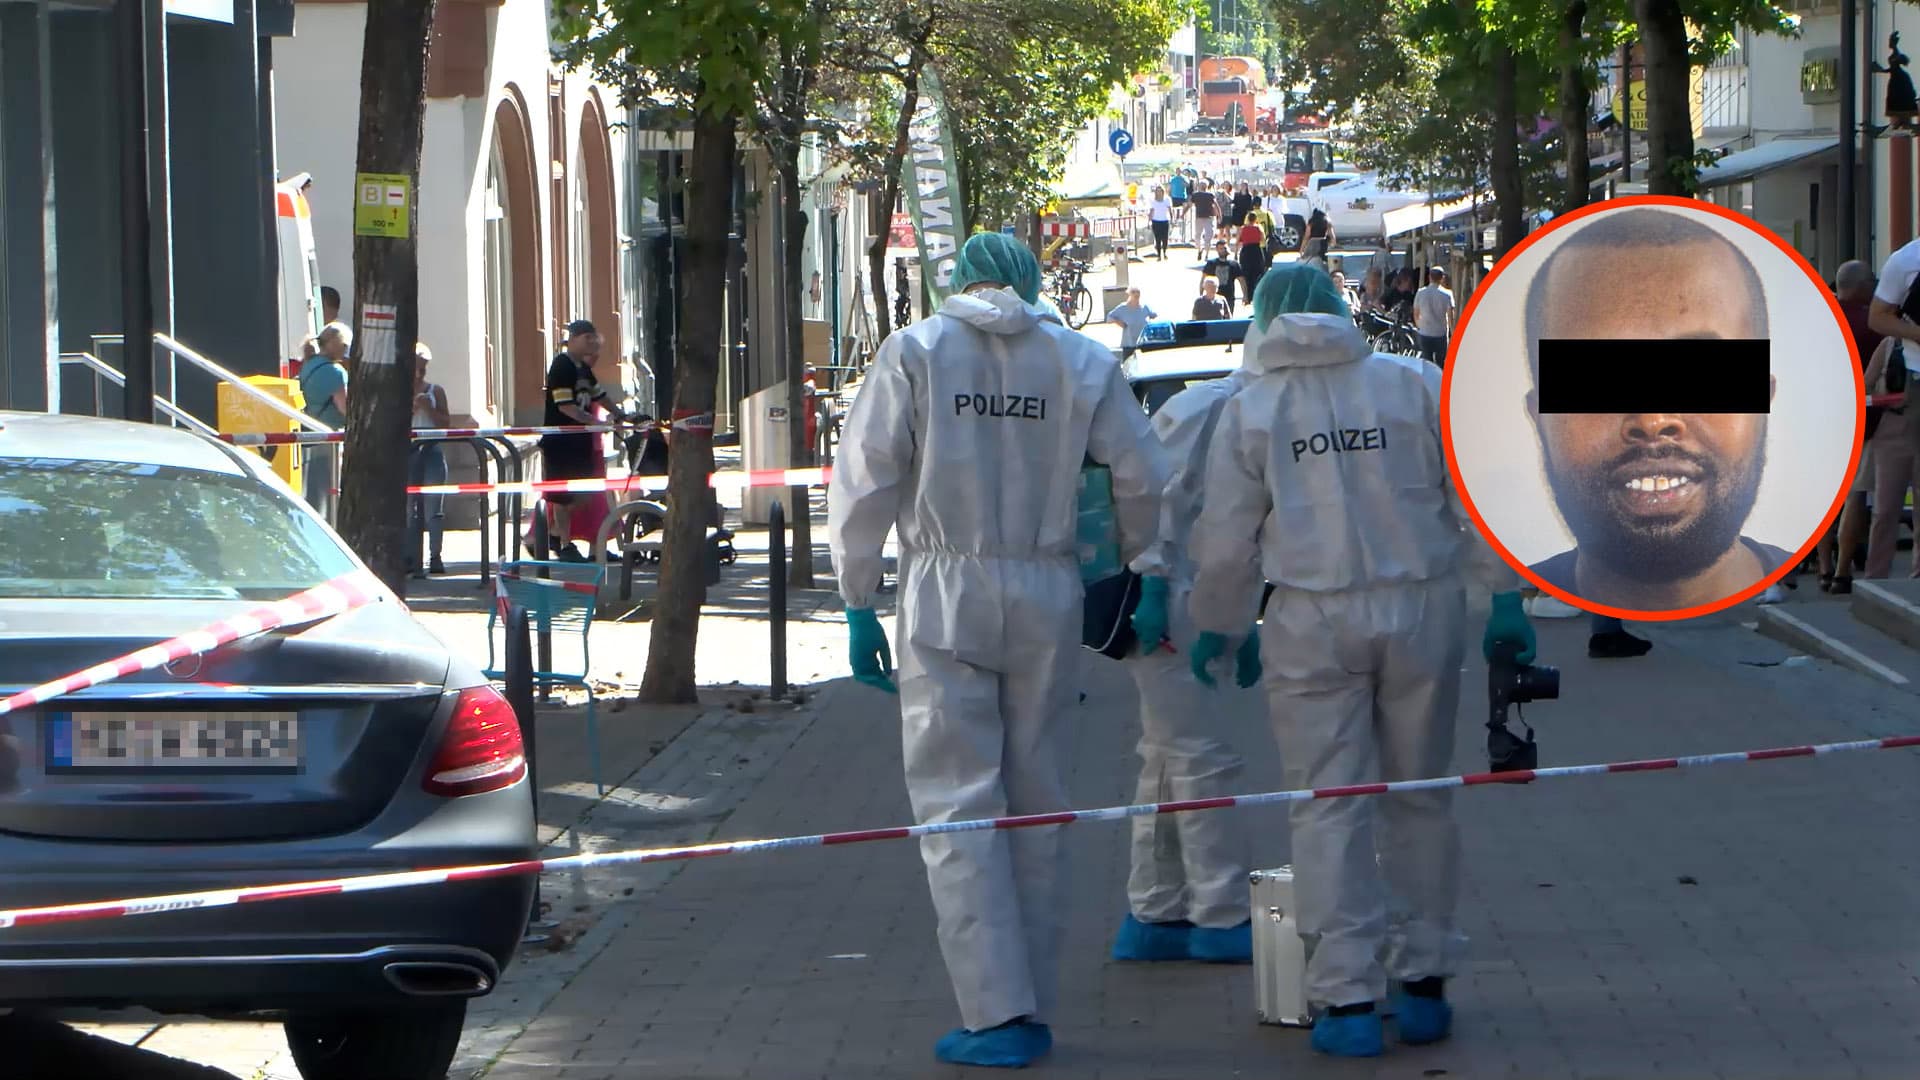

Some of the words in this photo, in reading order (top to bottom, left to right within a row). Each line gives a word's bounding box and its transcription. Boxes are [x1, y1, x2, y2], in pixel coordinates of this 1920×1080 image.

[367, 187, 377, 202] B
[954, 393, 1047, 420] POLIZEI
[1291, 427, 1387, 463] POLIZEI
